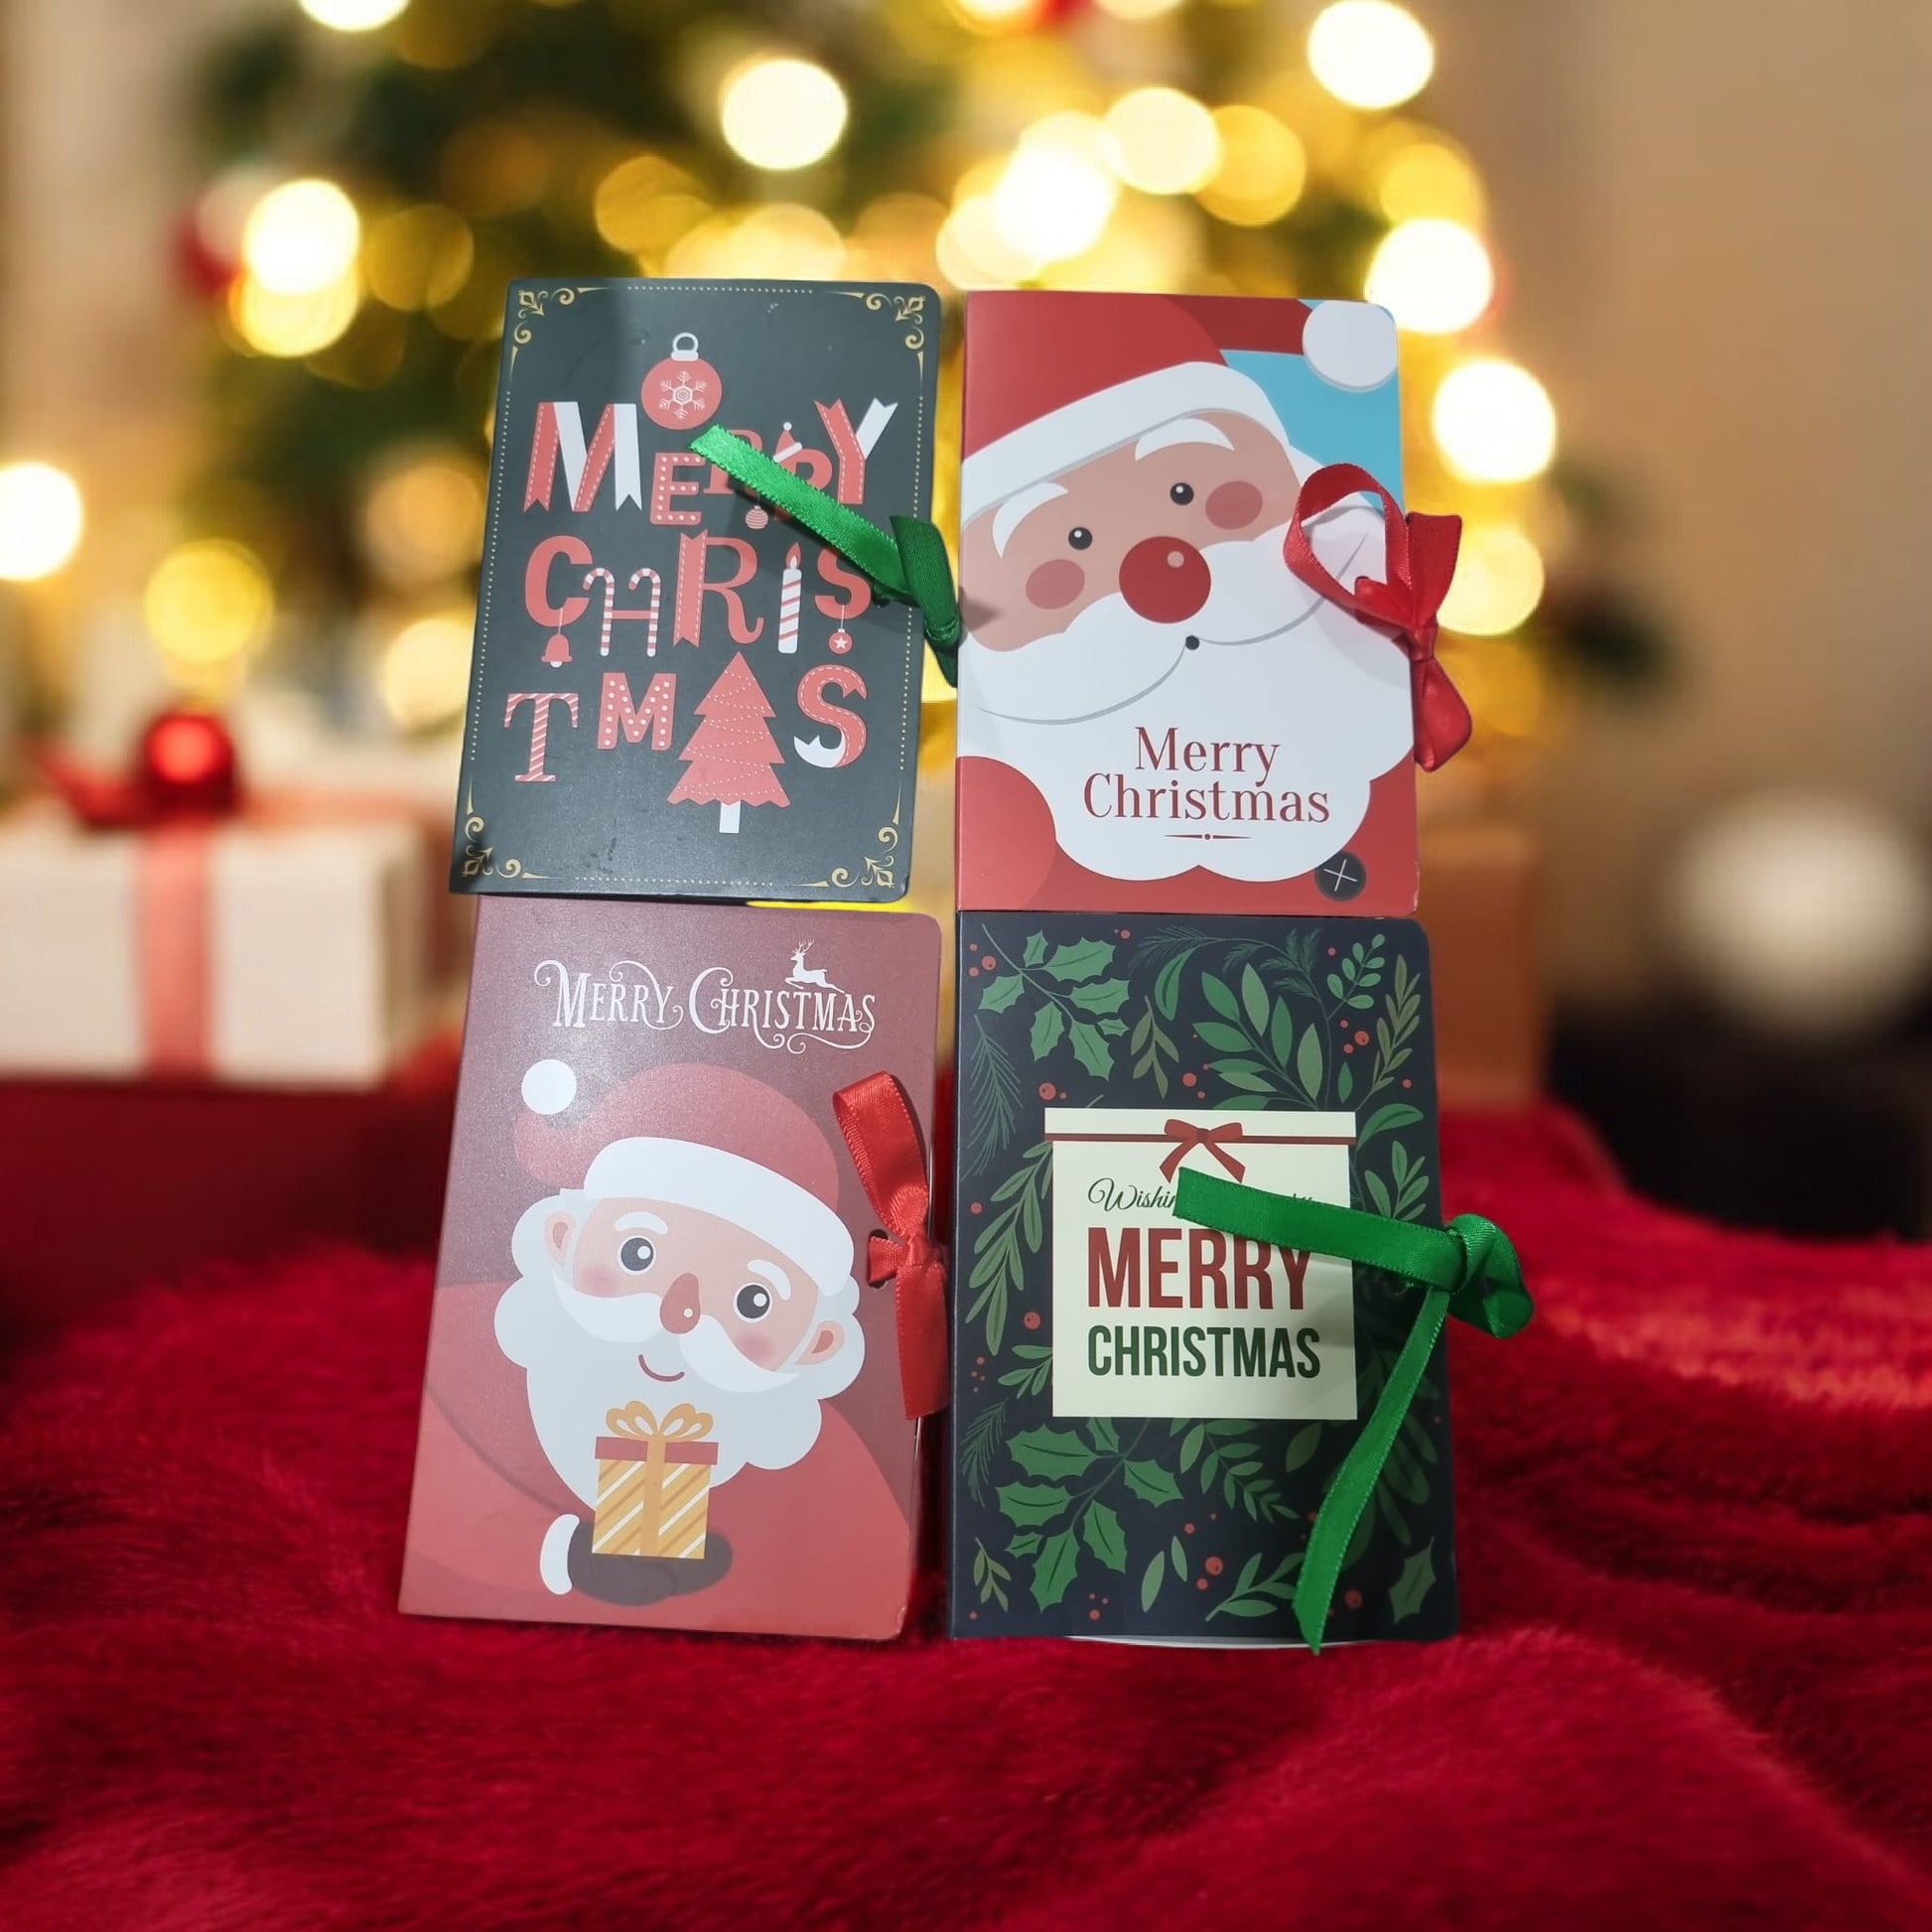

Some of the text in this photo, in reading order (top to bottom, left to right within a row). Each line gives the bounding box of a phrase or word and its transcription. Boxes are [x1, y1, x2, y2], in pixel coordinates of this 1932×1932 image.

[1135, 726, 1281, 786] Merry
[1083, 772, 1330, 823] Christmas
[534, 959, 876, 1053] MERRY CHRISTMAS
[1088, 1177, 1175, 1211] Wishi
[1088, 1227, 1311, 1311] MERRY
[1088, 1324, 1321, 1379] CHRISTMAS
